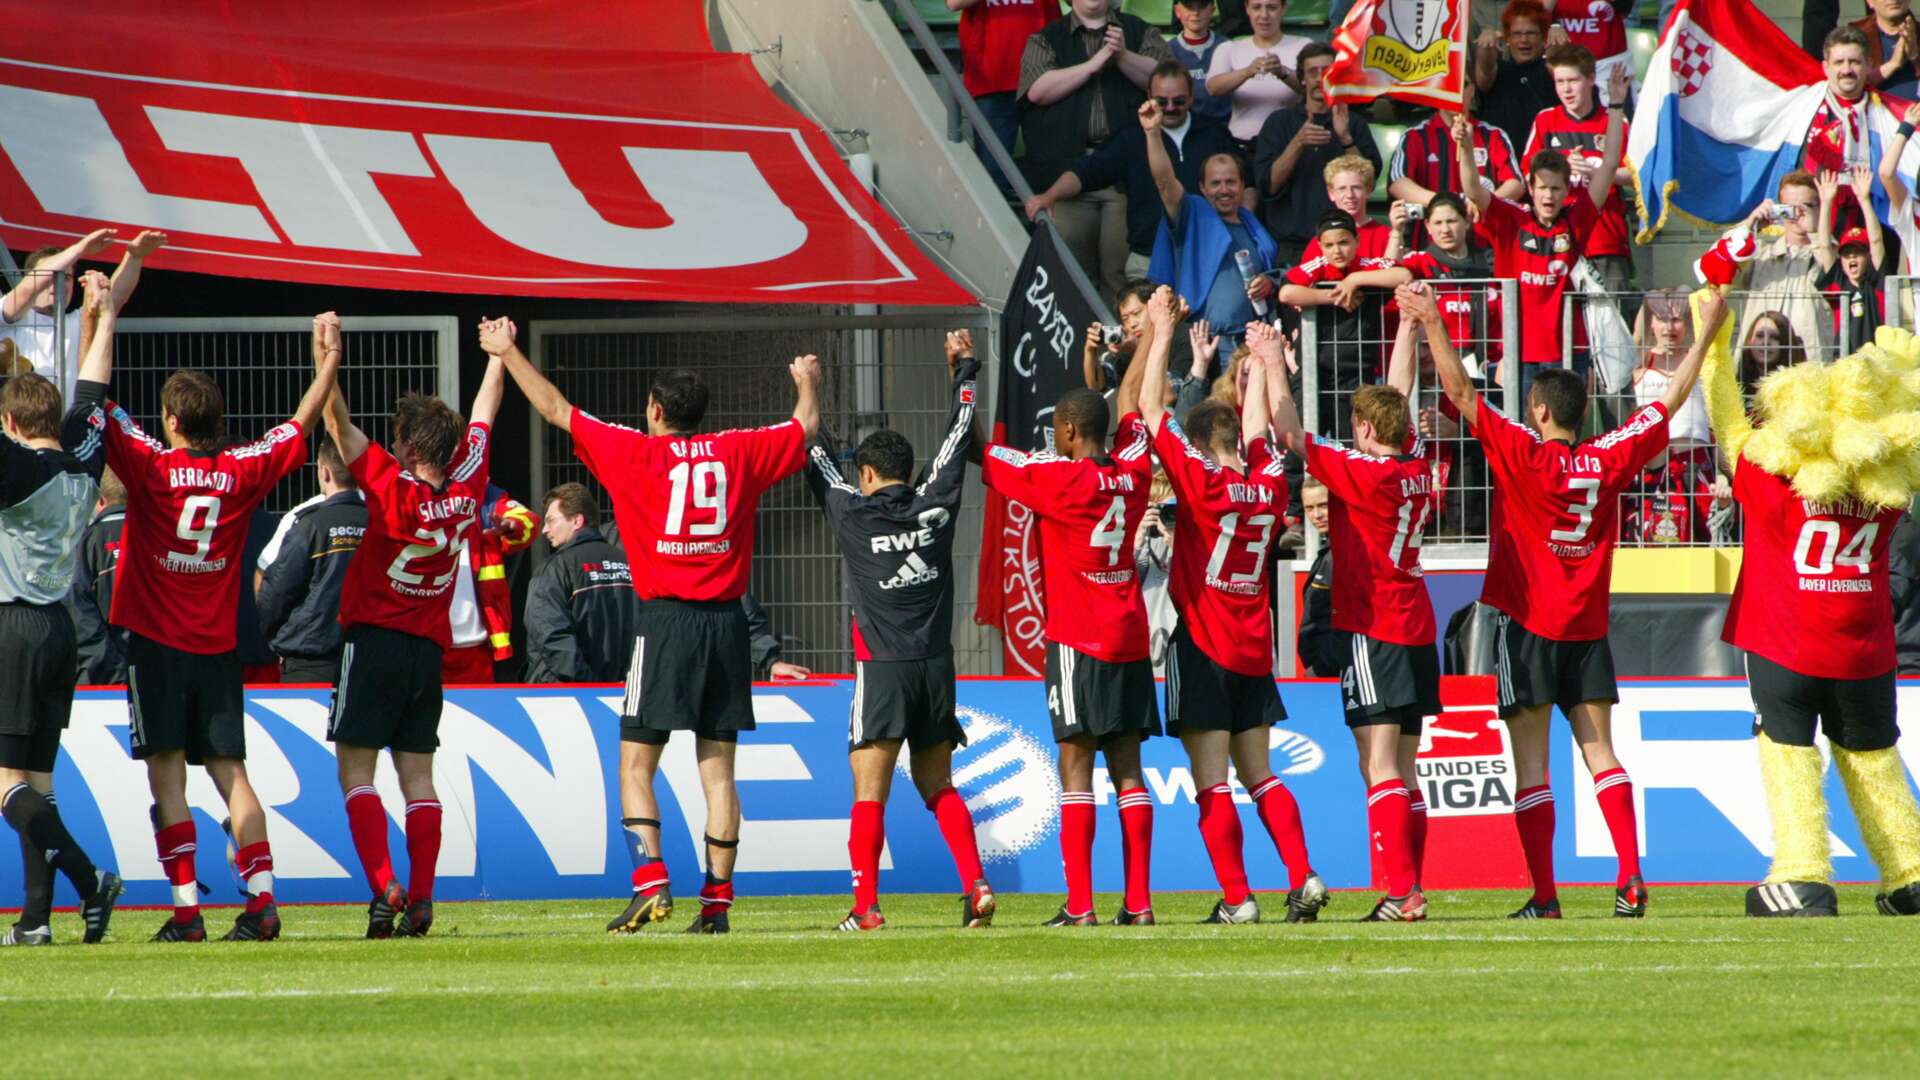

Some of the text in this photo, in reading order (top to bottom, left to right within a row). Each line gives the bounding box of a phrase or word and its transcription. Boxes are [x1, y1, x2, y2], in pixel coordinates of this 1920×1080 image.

[0, 85, 808, 270] LTU
[1520, 271, 1557, 286] RWE
[1446, 300, 1471, 313] RW
[664, 461, 728, 536] 19
[1551, 478, 1601, 542] 3
[167, 494, 221, 562] 9
[329, 525, 367, 538] secur
[871, 526, 935, 554] RWE
[1089, 495, 1126, 567] 4
[656, 540, 684, 556] BAYER
[1205, 512, 1276, 583] 13
[1793, 519, 1880, 575] 04
[602, 560, 630, 572] Secu
[878, 566, 939, 589] adidas
[1799, 577, 1826, 591] BAYER
[1340, 665, 1355, 696] 4
[1049, 684, 1060, 716] 4
[1415, 760, 1507, 778] UNDES
[1427, 777, 1514, 810] IGA
